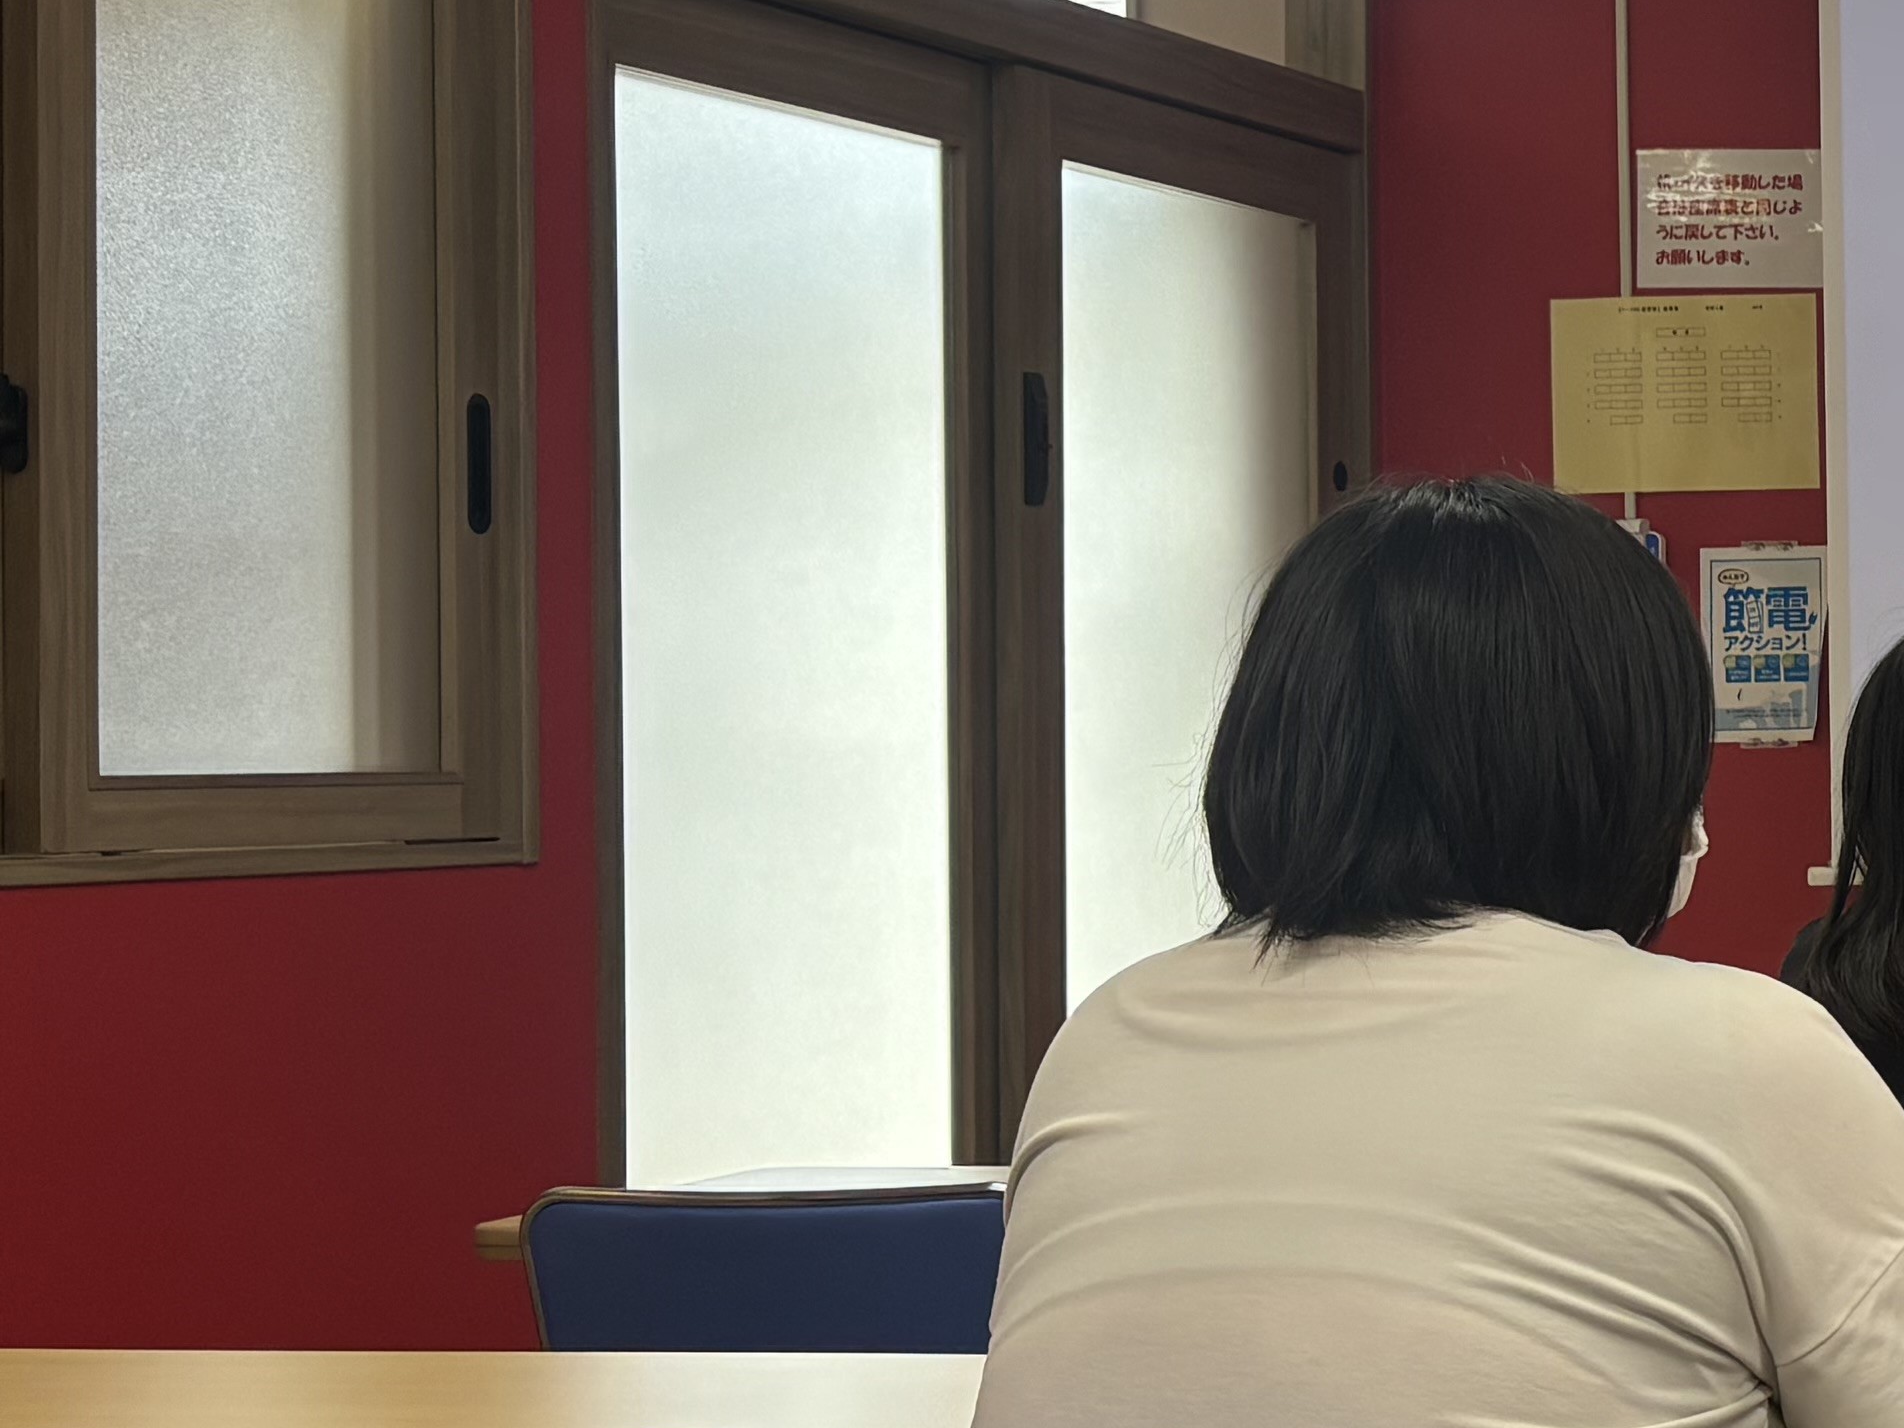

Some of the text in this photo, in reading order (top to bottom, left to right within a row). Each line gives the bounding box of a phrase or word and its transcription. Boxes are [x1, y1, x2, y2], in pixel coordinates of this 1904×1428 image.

[1656, 224, 1779, 241] うに戻して下さい。
[1656, 249, 1750, 266] お願いします。
[1723, 586, 1810, 634] 節電
